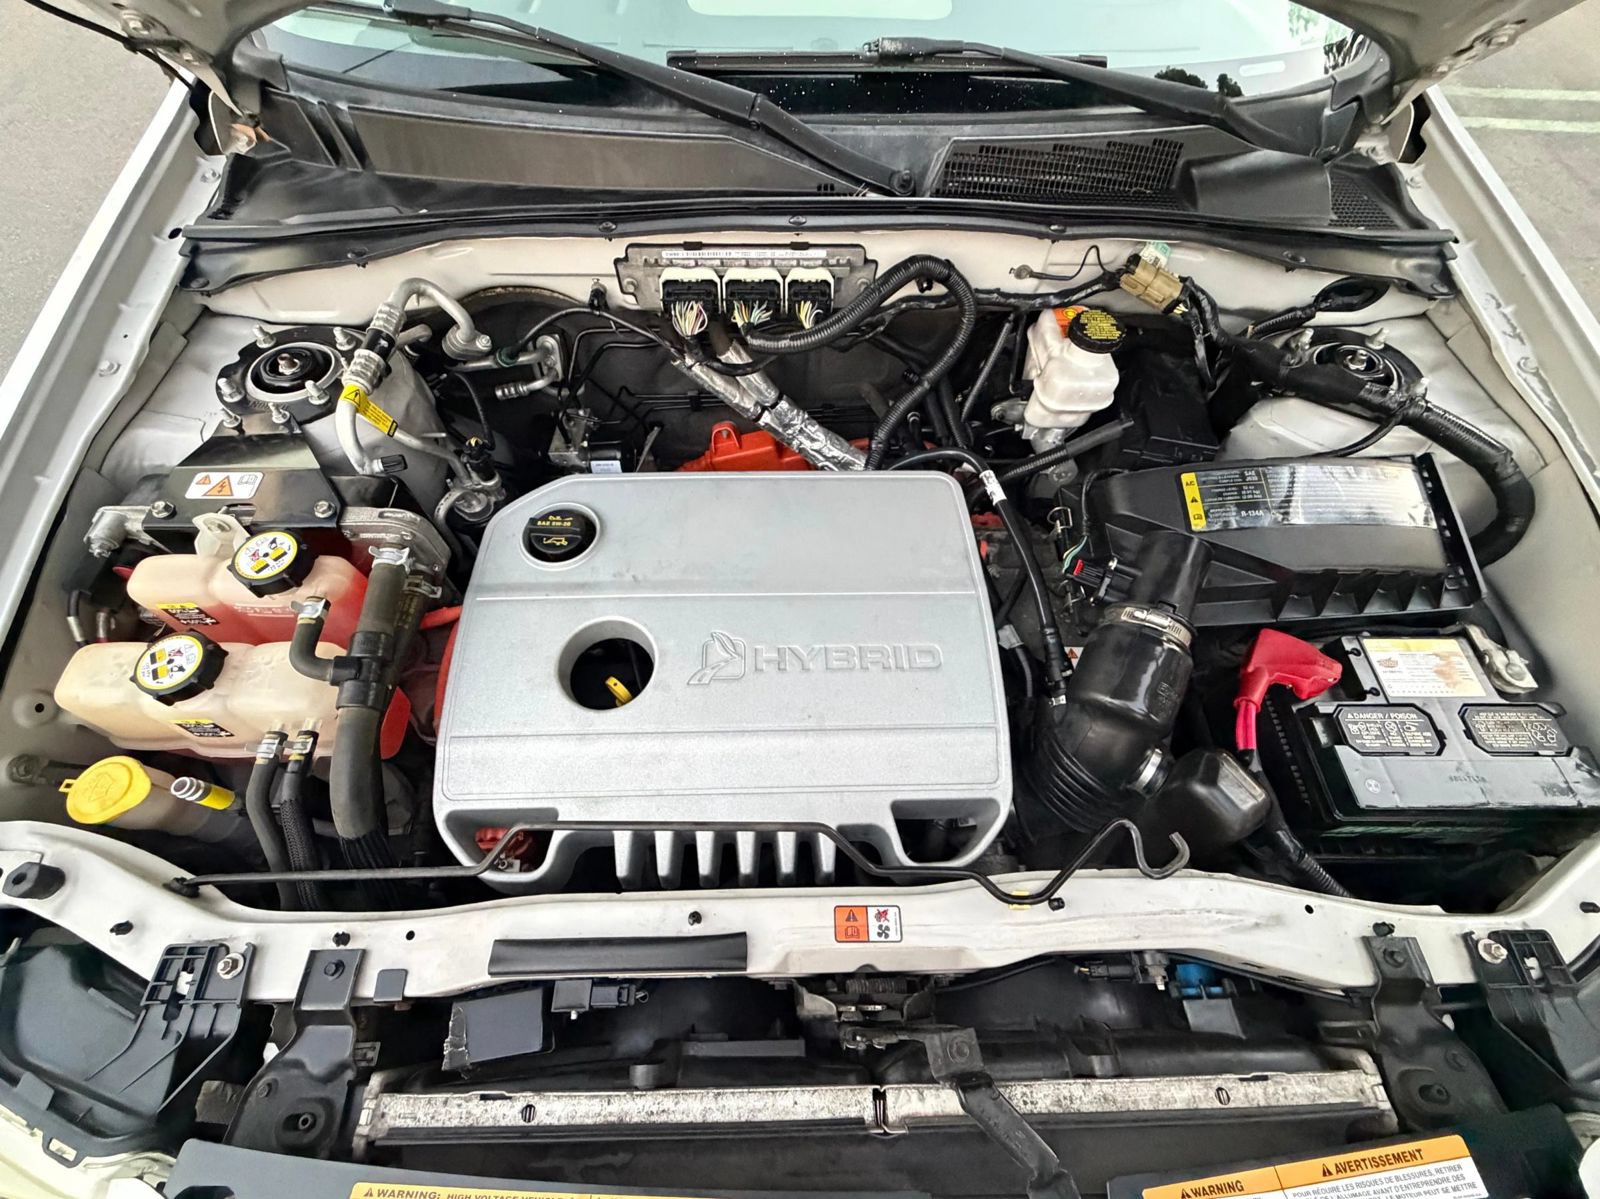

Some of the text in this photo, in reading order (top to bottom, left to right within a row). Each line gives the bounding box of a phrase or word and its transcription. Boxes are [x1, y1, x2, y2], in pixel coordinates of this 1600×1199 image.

[753, 643, 944, 673] HYBRID
[1335, 1148, 1423, 1174] AVERTISSEMENT
[1190, 1180, 1244, 1198] WARNING
[1292, 1189, 1312, 1198] POUR
[1341, 1182, 1355, 1192] LES
[1355, 1178, 1385, 1189] RISQUES
[1384, 1175, 1394, 1184] DE
[1435, 1163, 1464, 1175] RETIRER
[1372, 1186, 1393, 1195] AVANT
[1451, 1173, 1466, 1182] DES
[1423, 1188, 1441, 1197] PEUT
[1441, 1186, 1451, 1194] SE
[1451, 1181, 1478, 1192] METTRE
[377, 1188, 441, 1199] WARNING:
